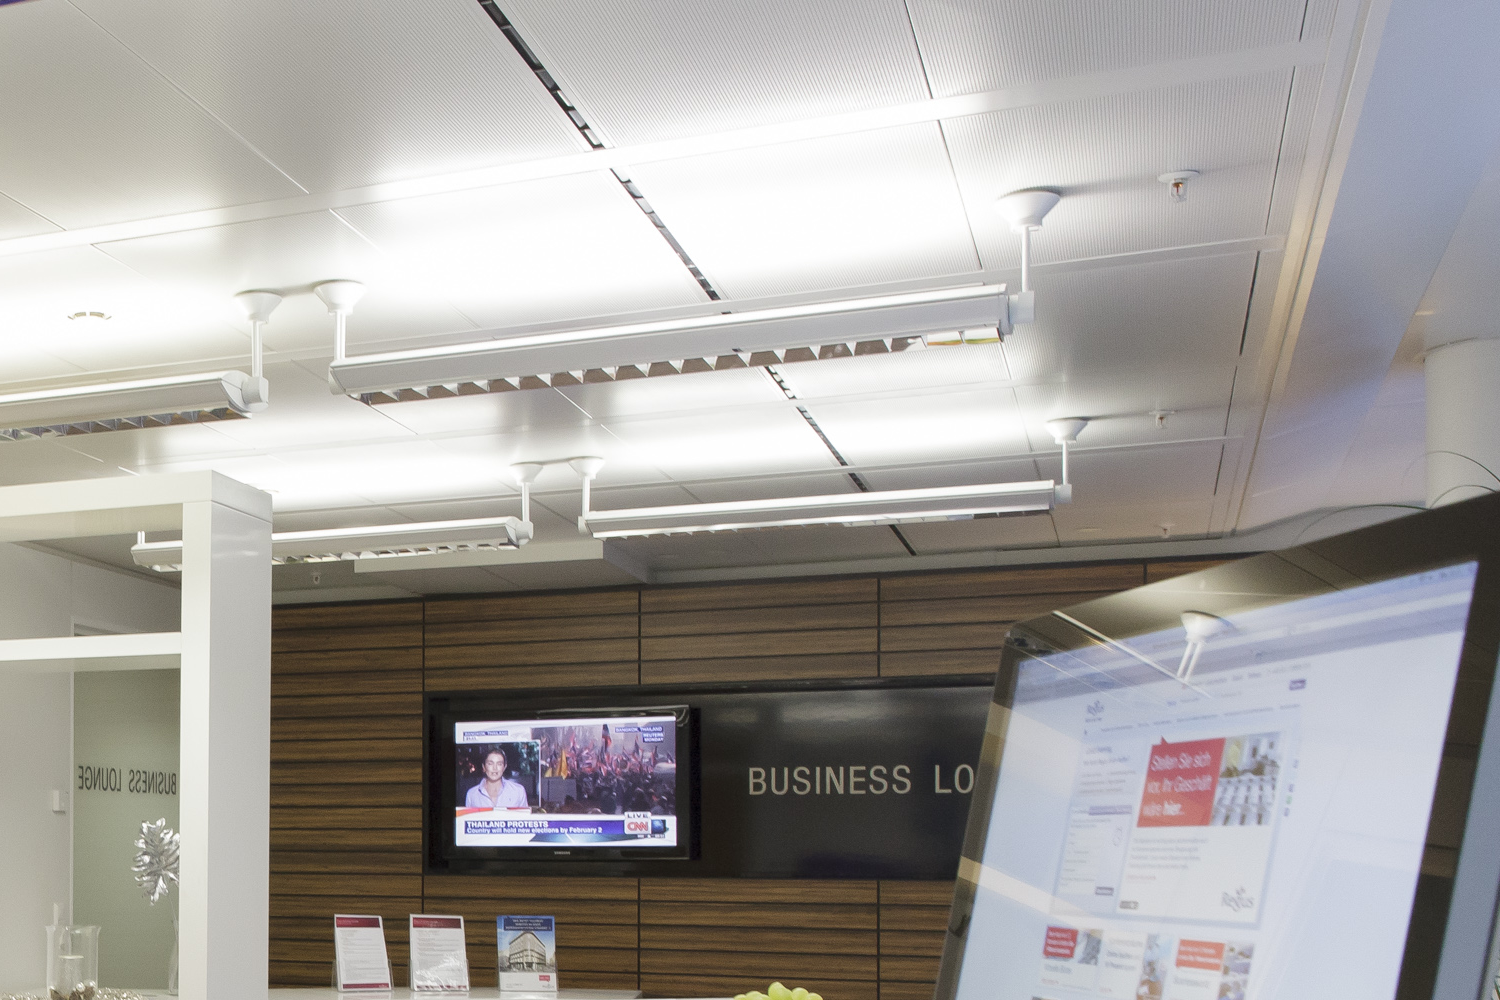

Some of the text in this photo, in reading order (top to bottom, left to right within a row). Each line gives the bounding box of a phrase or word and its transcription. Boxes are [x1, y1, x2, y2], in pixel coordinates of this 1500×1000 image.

[748, 764, 912, 795] BUSINESS
[466, 820, 549, 828] THAILAND PROTESTS
[626, 821, 649, 832] CNN
[466, 827, 490, 835] Country
[559, 827, 569, 835] by
[569, 827, 597, 835] February
